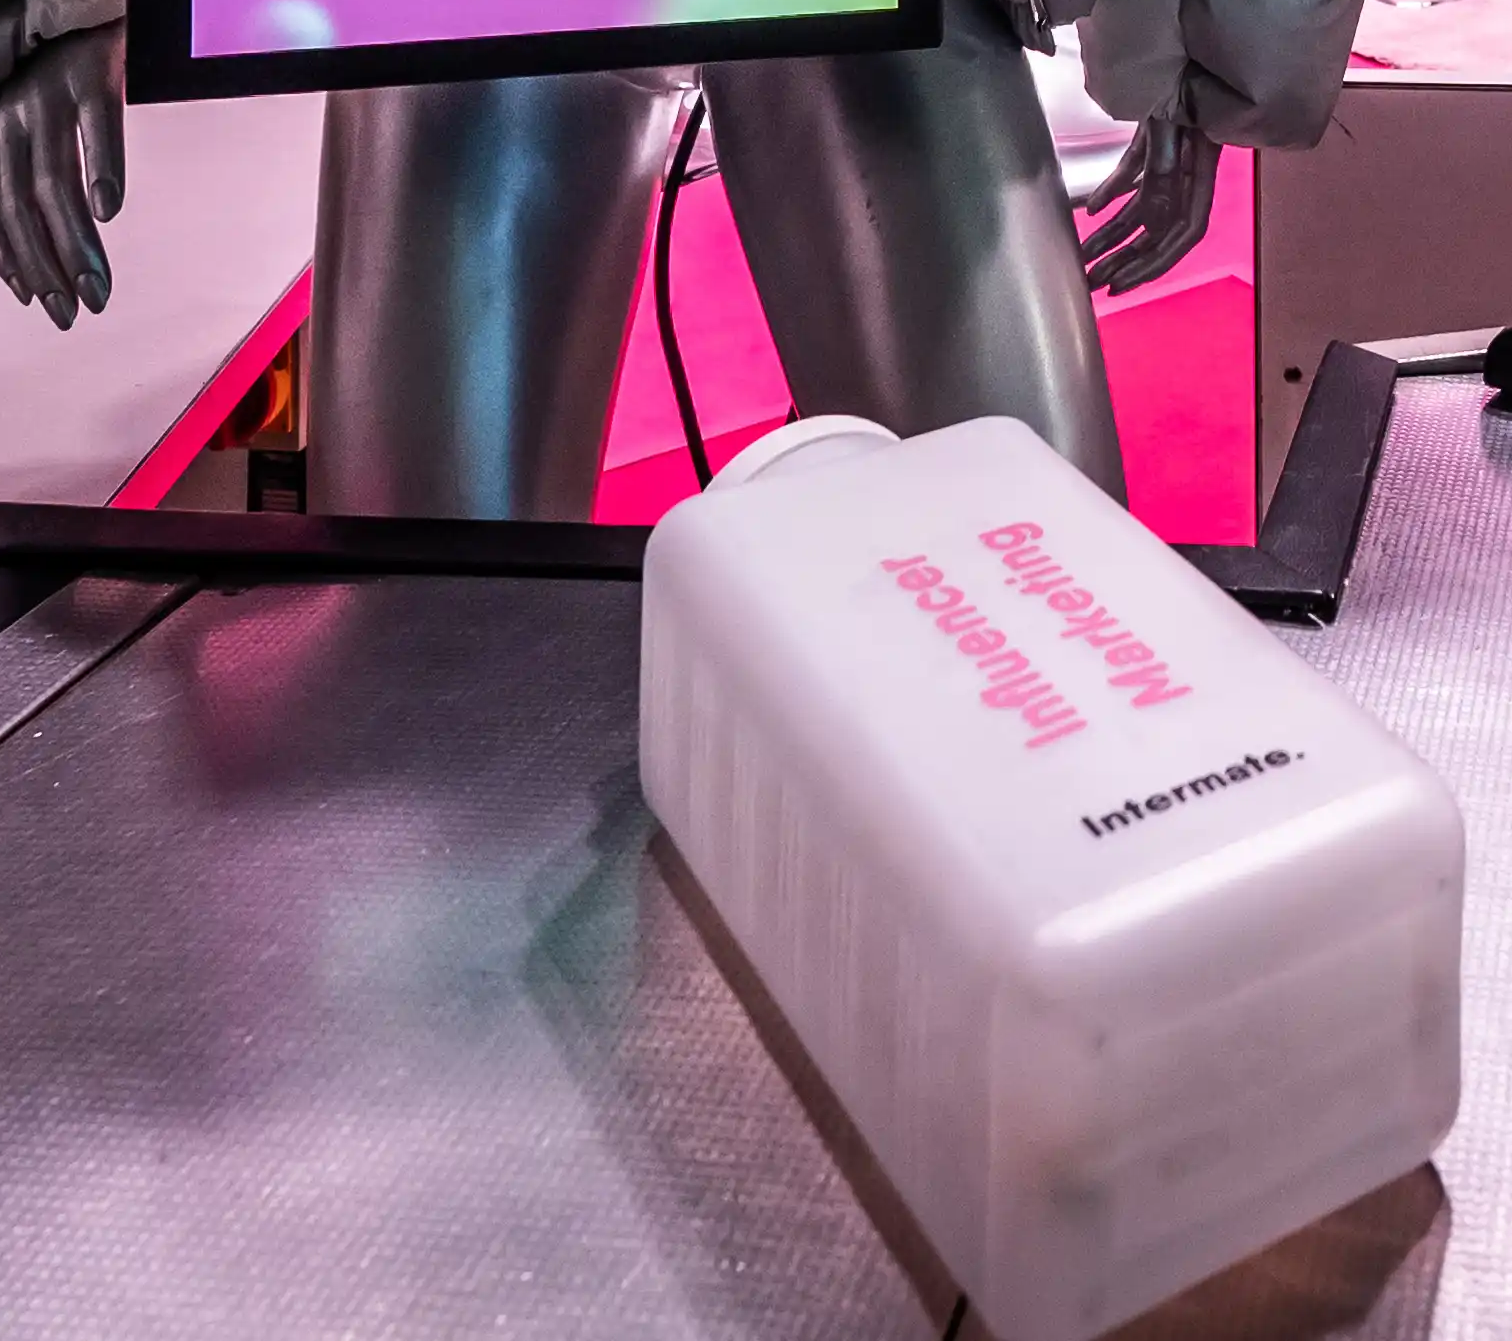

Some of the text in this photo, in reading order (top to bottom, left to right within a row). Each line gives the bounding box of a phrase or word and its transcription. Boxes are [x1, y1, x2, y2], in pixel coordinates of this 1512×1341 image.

[881, 551, 1088, 753] Influencer
[978, 519, 1194, 710] Marketing
[1083, 745, 1307, 841] Intermate.
